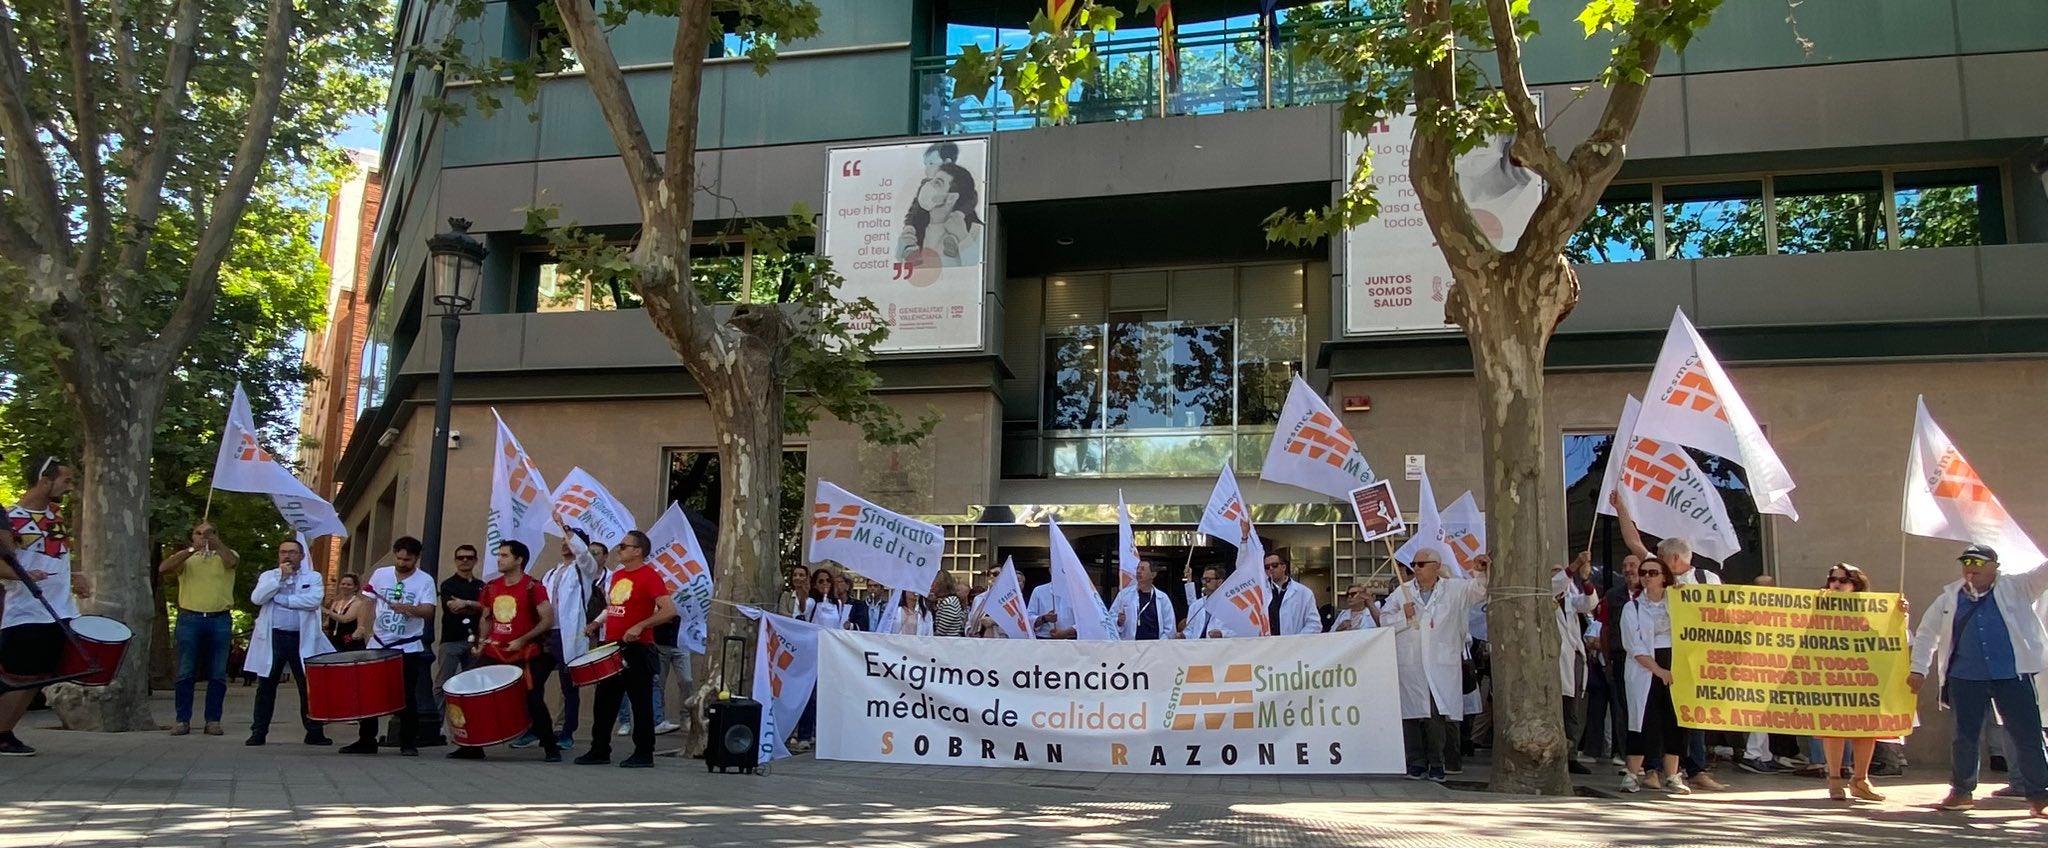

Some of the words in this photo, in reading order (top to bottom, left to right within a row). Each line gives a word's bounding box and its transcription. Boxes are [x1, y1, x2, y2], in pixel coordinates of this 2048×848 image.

[1377, 144, 1392, 154] Lo
[1396, 144, 1411, 155] qu
[879, 178, 893, 187] Ja
[1371, 174, 1384, 184] te
[865, 192, 892, 202] saps
[1398, 188, 1416, 197] no
[838, 207, 861, 218] que
[863, 205, 874, 215] hi
[876, 205, 892, 215] ha
[1384, 216, 1424, 228] todos
[857, 217, 891, 229] molta
[864, 232, 890, 245] gent
[858, 246, 870, 256] al
[871, 246, 890, 255] teu
[853, 259, 889, 270] costat
[1365, 274, 1412, 286] JUNTOS
[1368, 286, 1412, 297] SOMOS
[1373, 297, 1412, 308] SALUD
[899, 306, 944, 314] GENERALITAT
[1661, 351, 1699, 401] cesmcv
[1283, 408, 1313, 451] cesmcv
[860, 507, 935, 545] Sindicato
[853, 526, 927, 567] Médico
[1681, 589, 1701, 603] NO
[1706, 590, 1717, 603] A
[1720, 590, 1746, 605] LAS
[1749, 592, 1812, 610] AGENDAS
[1815, 595, 1888, 613] INFINITAS
[1699, 606, 1787, 627] TRANSPORTE
[1790, 612, 1870, 631] SANITARIO
[1680, 627, 1752, 645] JORNADAS
[1756, 631, 1773, 647] DE
[1776, 633, 1796, 648] 35
[1800, 634, 1850, 651] HORAS
[1853, 636, 1902, 653] ¡¡YA!!
[864, 651, 1000, 690] Exigimos
[1012, 662, 1150, 690] atención
[1706, 649, 1788, 668] SEGURIDAD
[1791, 655, 1812, 669] EN
[1814, 656, 1870, 671] TODOS
[1253, 660, 1358, 692] Sindicato
[1699, 665, 1728, 680] LOS
[1730, 667, 1798, 685] CENTROS
[1801, 671, 1822, 686] DE
[1825, 672, 1879, 687] SALUD
[1162, 666, 1184, 729] cesmcv
[1696, 685, 1766, 704] MEJORAS
[1769, 690, 1881, 708] RETRIBUTIVAS
[866, 692, 970, 723] médica
[981, 698, 1018, 728] de
[1031, 701, 1147, 730] calidad
[1258, 695, 1361, 729] Médico
[1679, 705, 1727, 724] S.O.S.
[1730, 708, 1815, 731] ATENCIÓN
[1819, 713, 1912, 733] PRIMARIA
[881, 731, 1063, 763] SOBRAN
[1111, 742, 1343, 767] RAZONES
